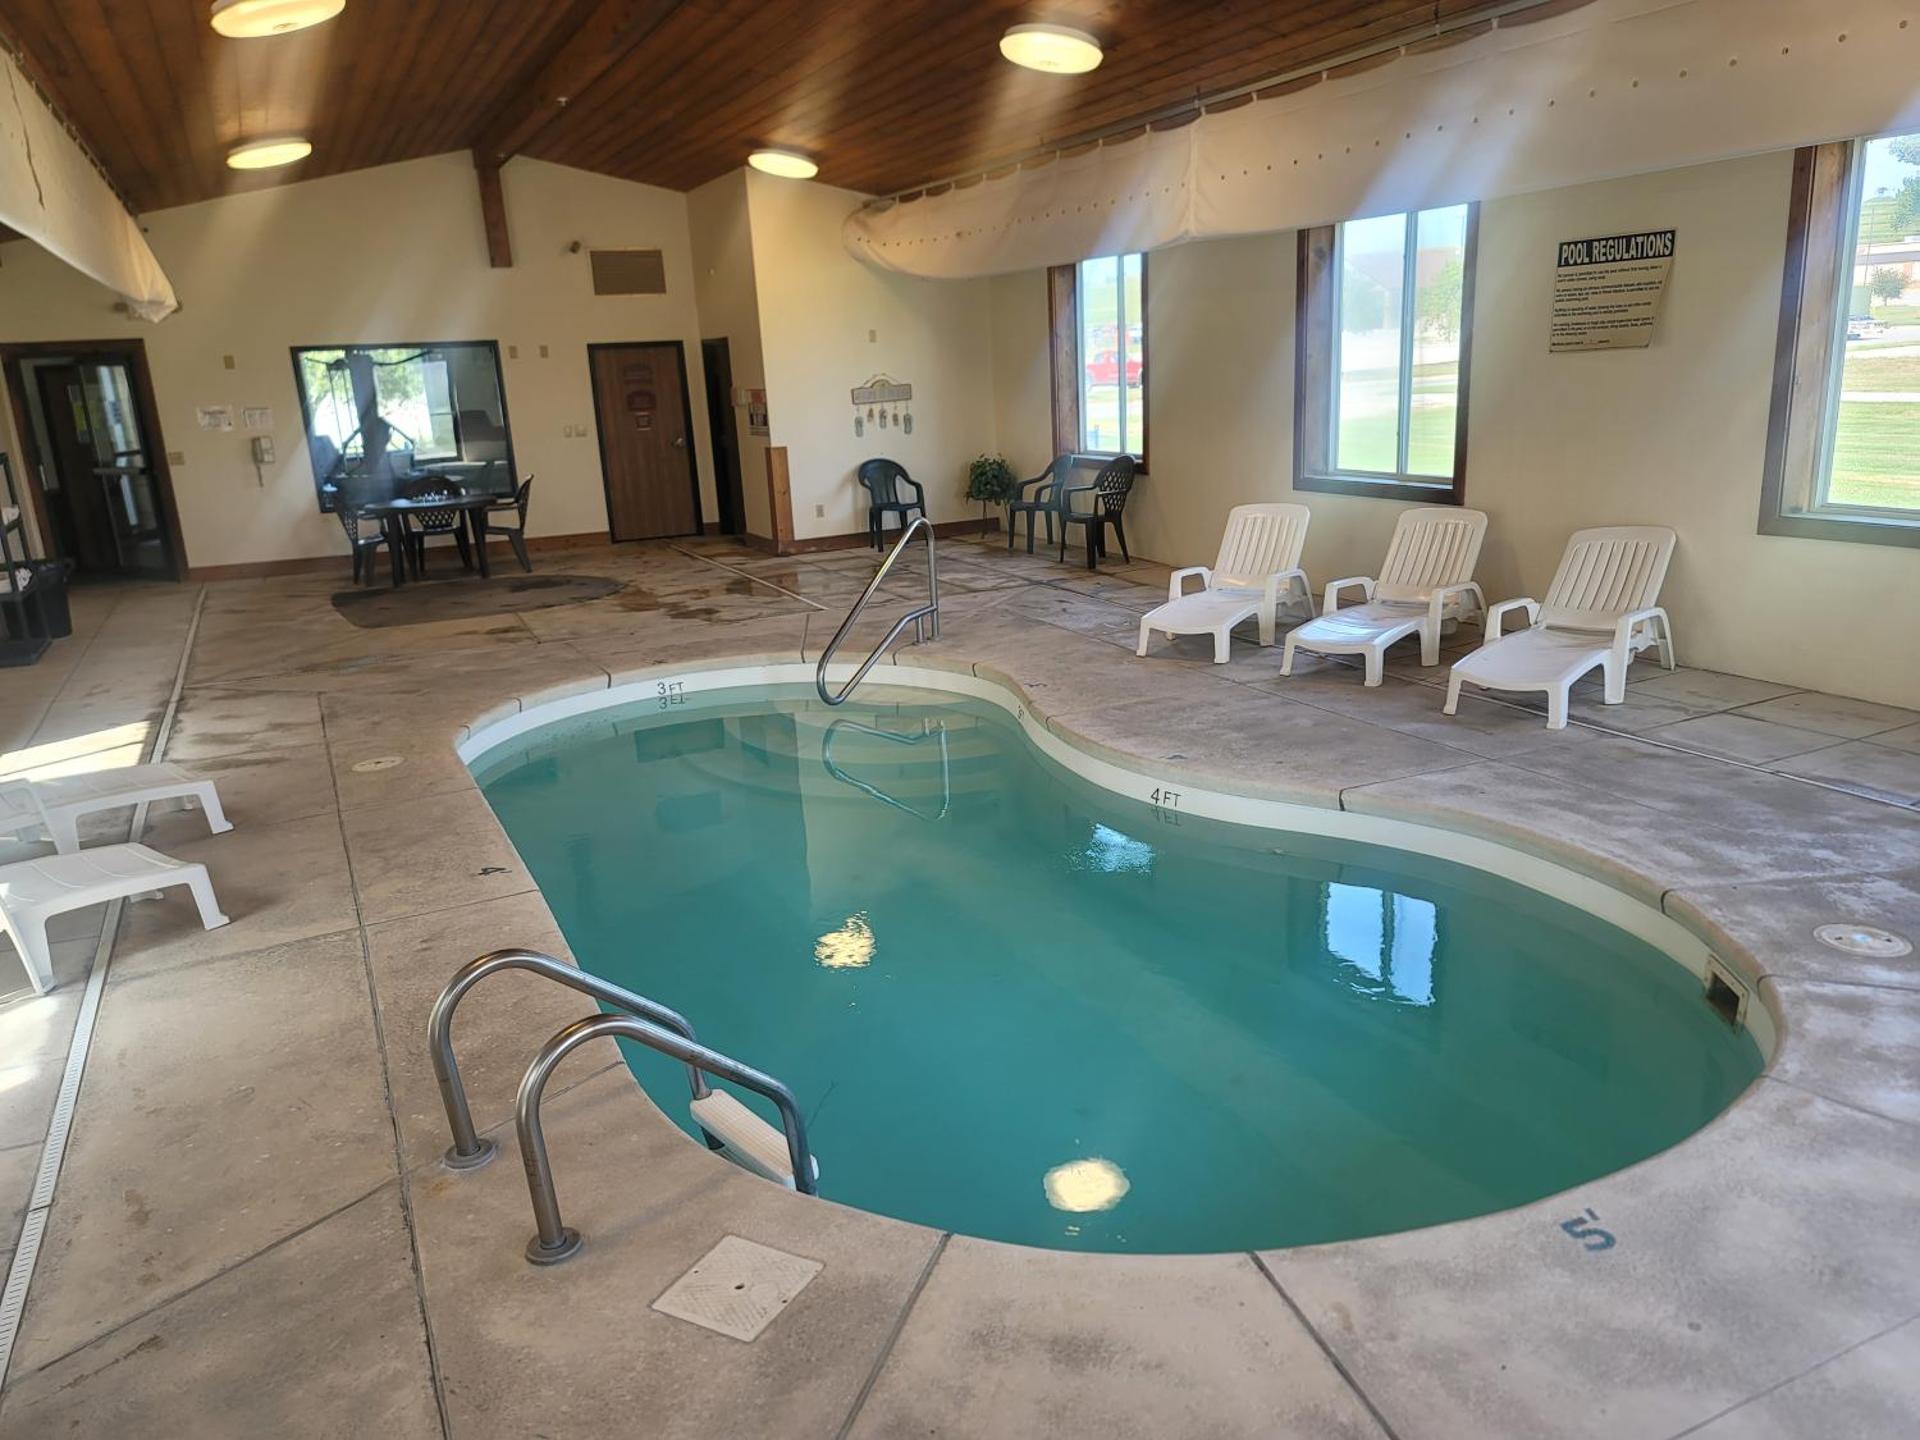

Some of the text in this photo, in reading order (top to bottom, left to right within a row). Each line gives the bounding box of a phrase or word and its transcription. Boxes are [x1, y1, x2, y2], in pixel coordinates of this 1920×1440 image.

[1560, 232, 1673, 266] POOL REGULATIONS
[657, 682, 684, 696] 3 FT
[1150, 787, 1182, 808] 4 FT
